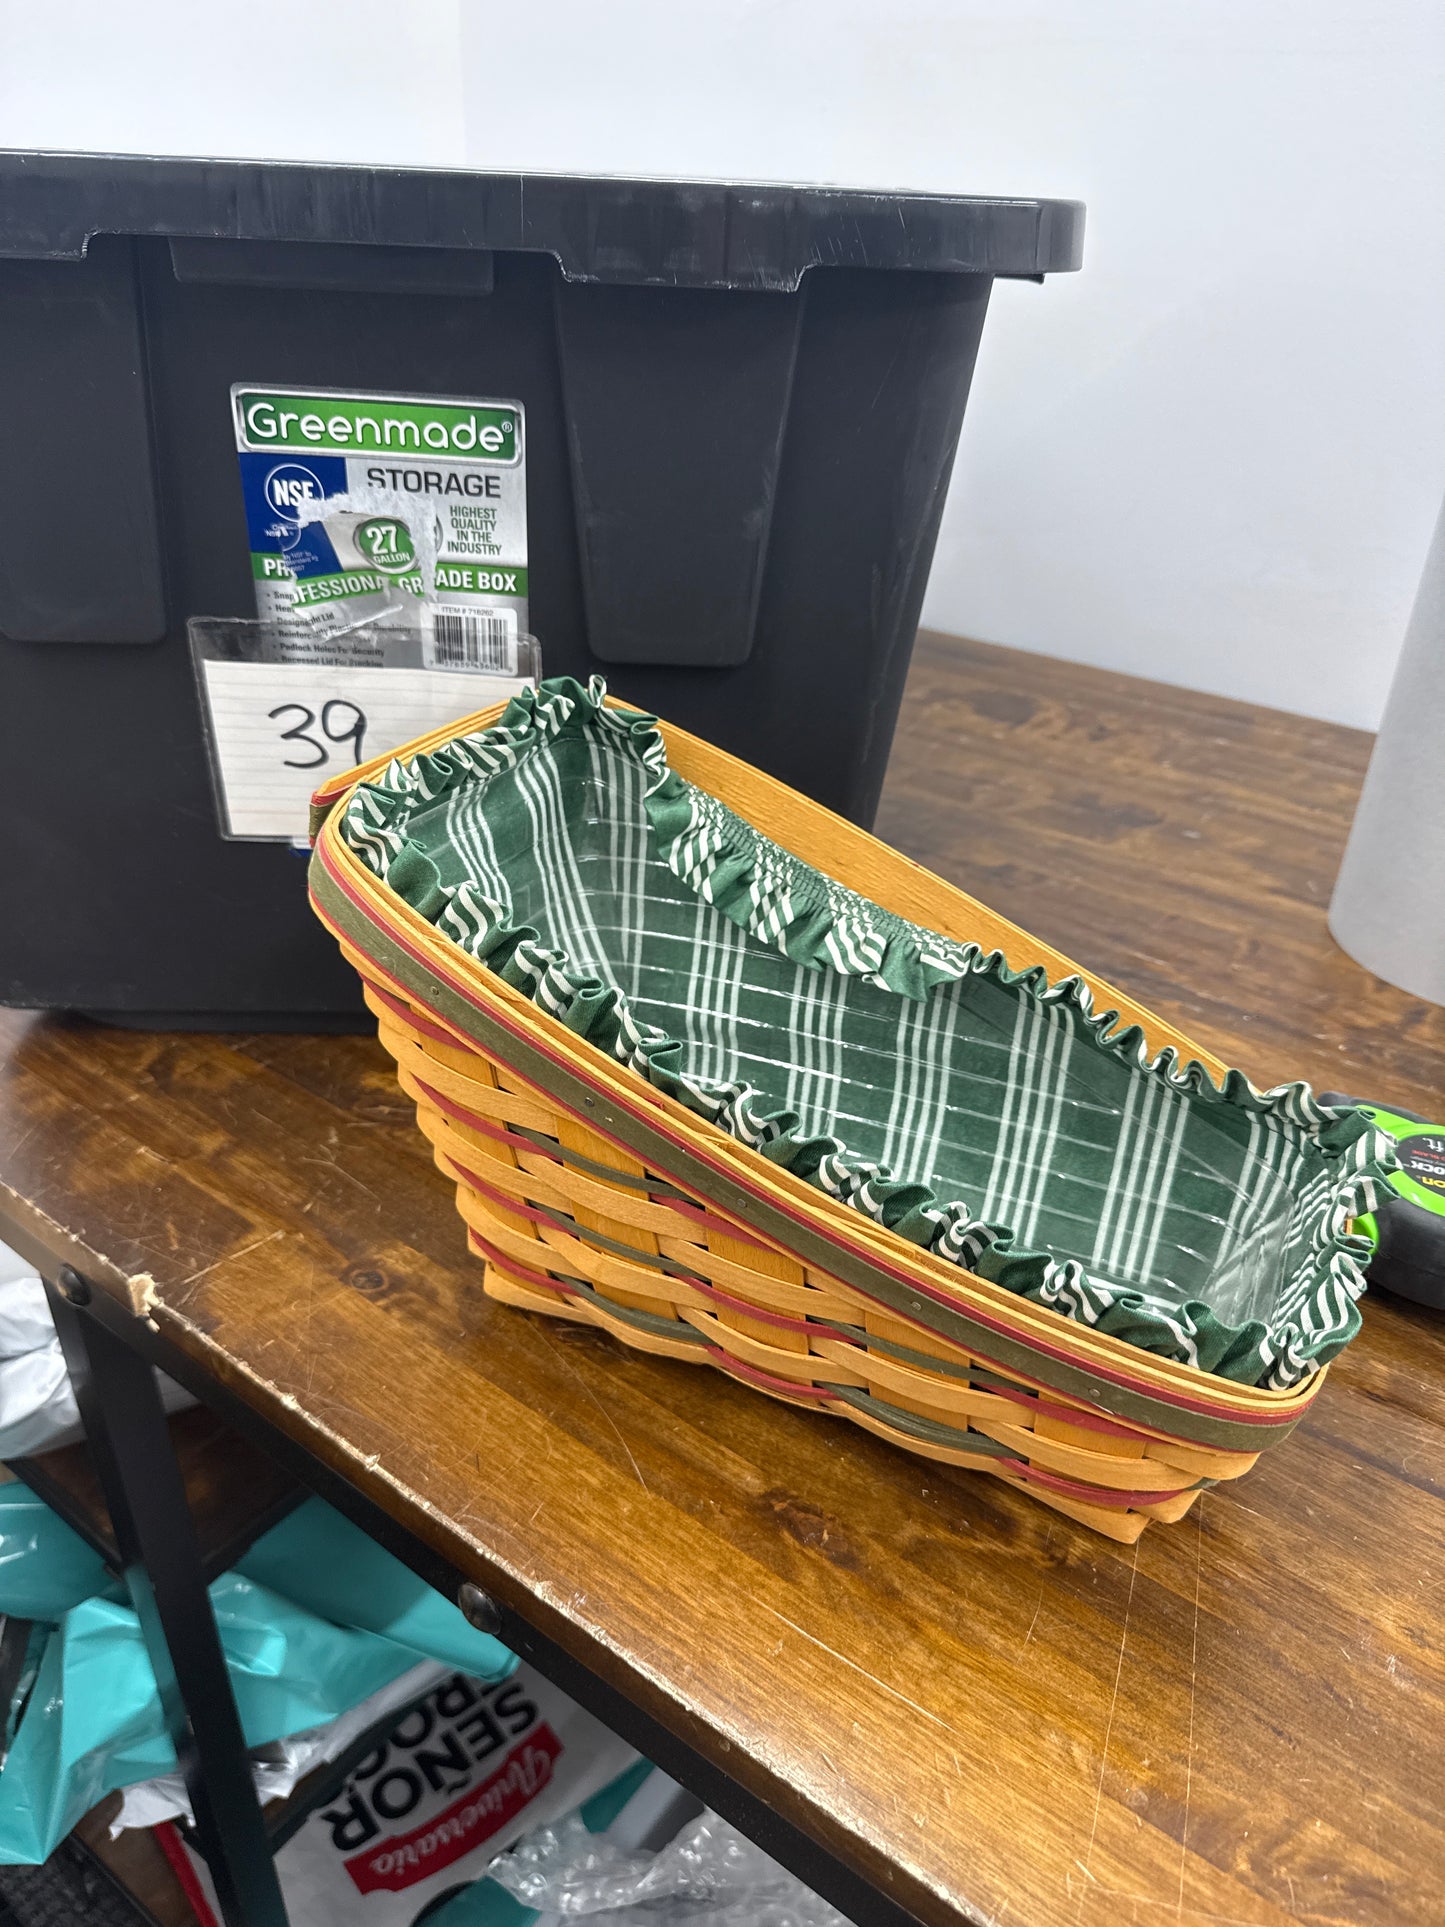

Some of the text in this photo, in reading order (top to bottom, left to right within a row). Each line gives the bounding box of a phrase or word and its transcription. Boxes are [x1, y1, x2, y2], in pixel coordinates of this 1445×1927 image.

[367, 467, 502, 499] STORAGE
[449, 505, 498, 520] HIGHEST
[451, 518, 497, 532] QUALITY
[365, 525, 398, 555] 27
[456, 530, 492, 543] IN THE
[447, 541, 502, 556] INDUSTRY
[373, 552, 411, 564] GALLON
[477, 571, 517, 592] BOX
[267, 699, 368, 770] 39
[320, 1681, 539, 1852] SEÑOR
